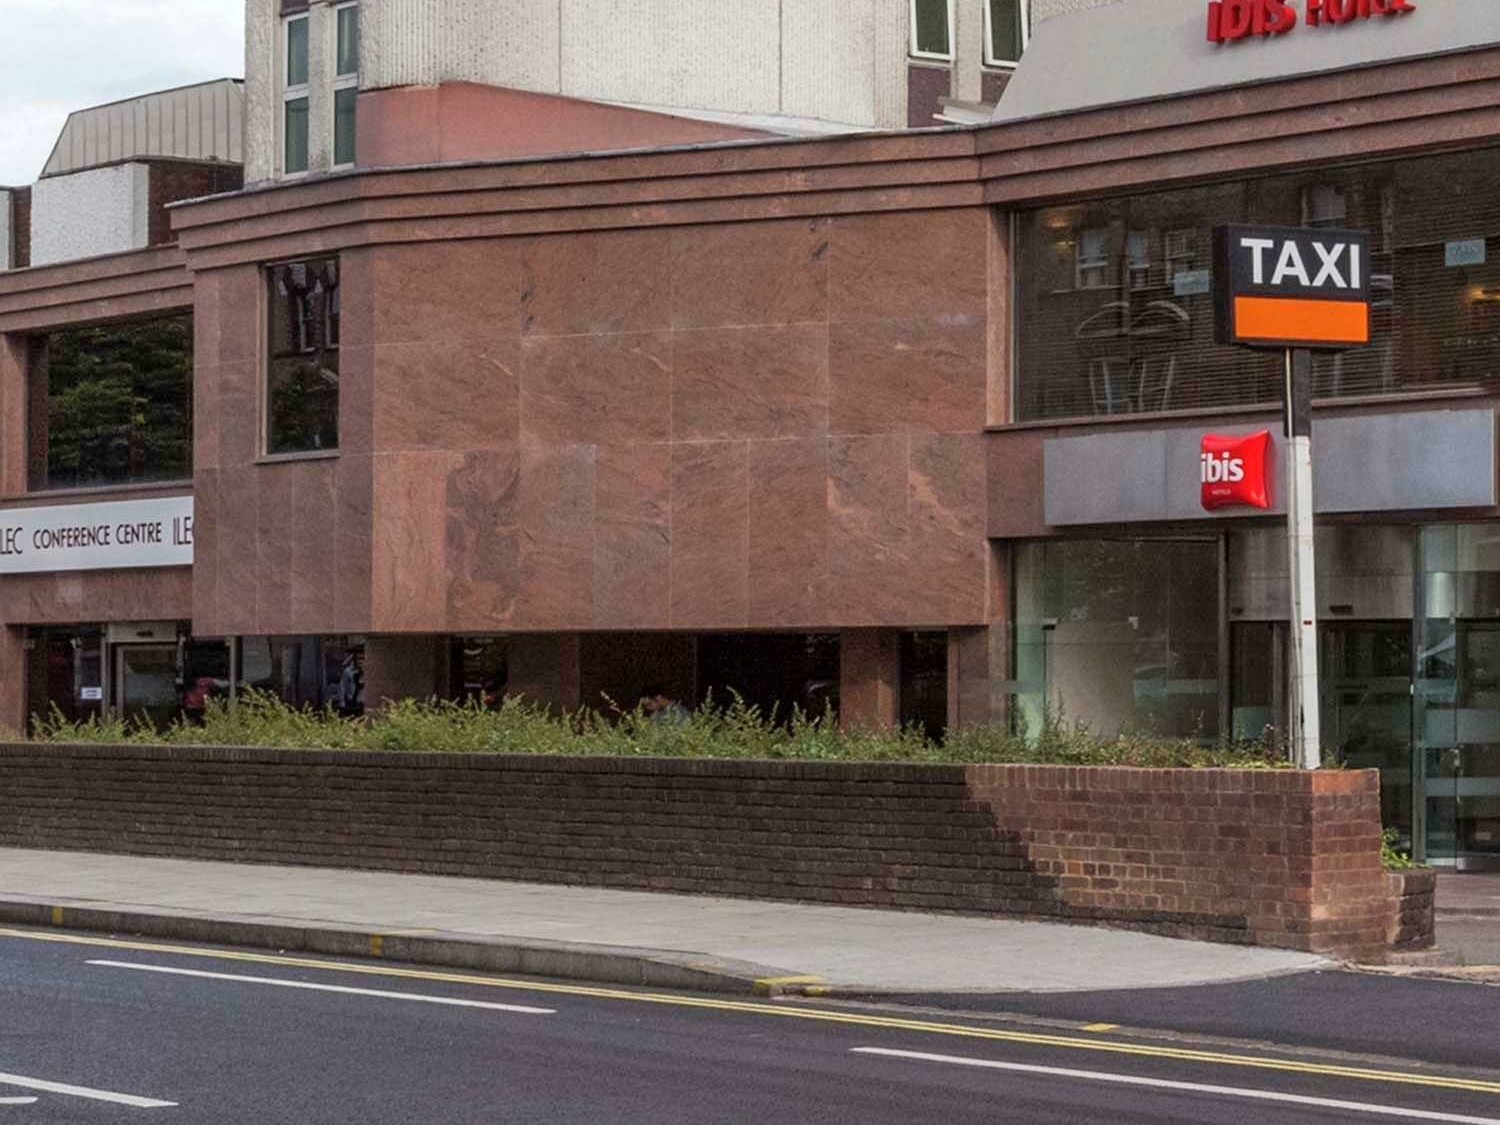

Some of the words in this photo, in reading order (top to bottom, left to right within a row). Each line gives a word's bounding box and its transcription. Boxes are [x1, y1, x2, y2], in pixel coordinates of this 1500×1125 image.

[1240, 237, 1361, 289] TAXI
[1200, 451, 1245, 483] ibis
[33, 525, 111, 549] CONFERENCE
[115, 522, 162, 545] CENTRE
[173, 516, 194, 545] ILE
